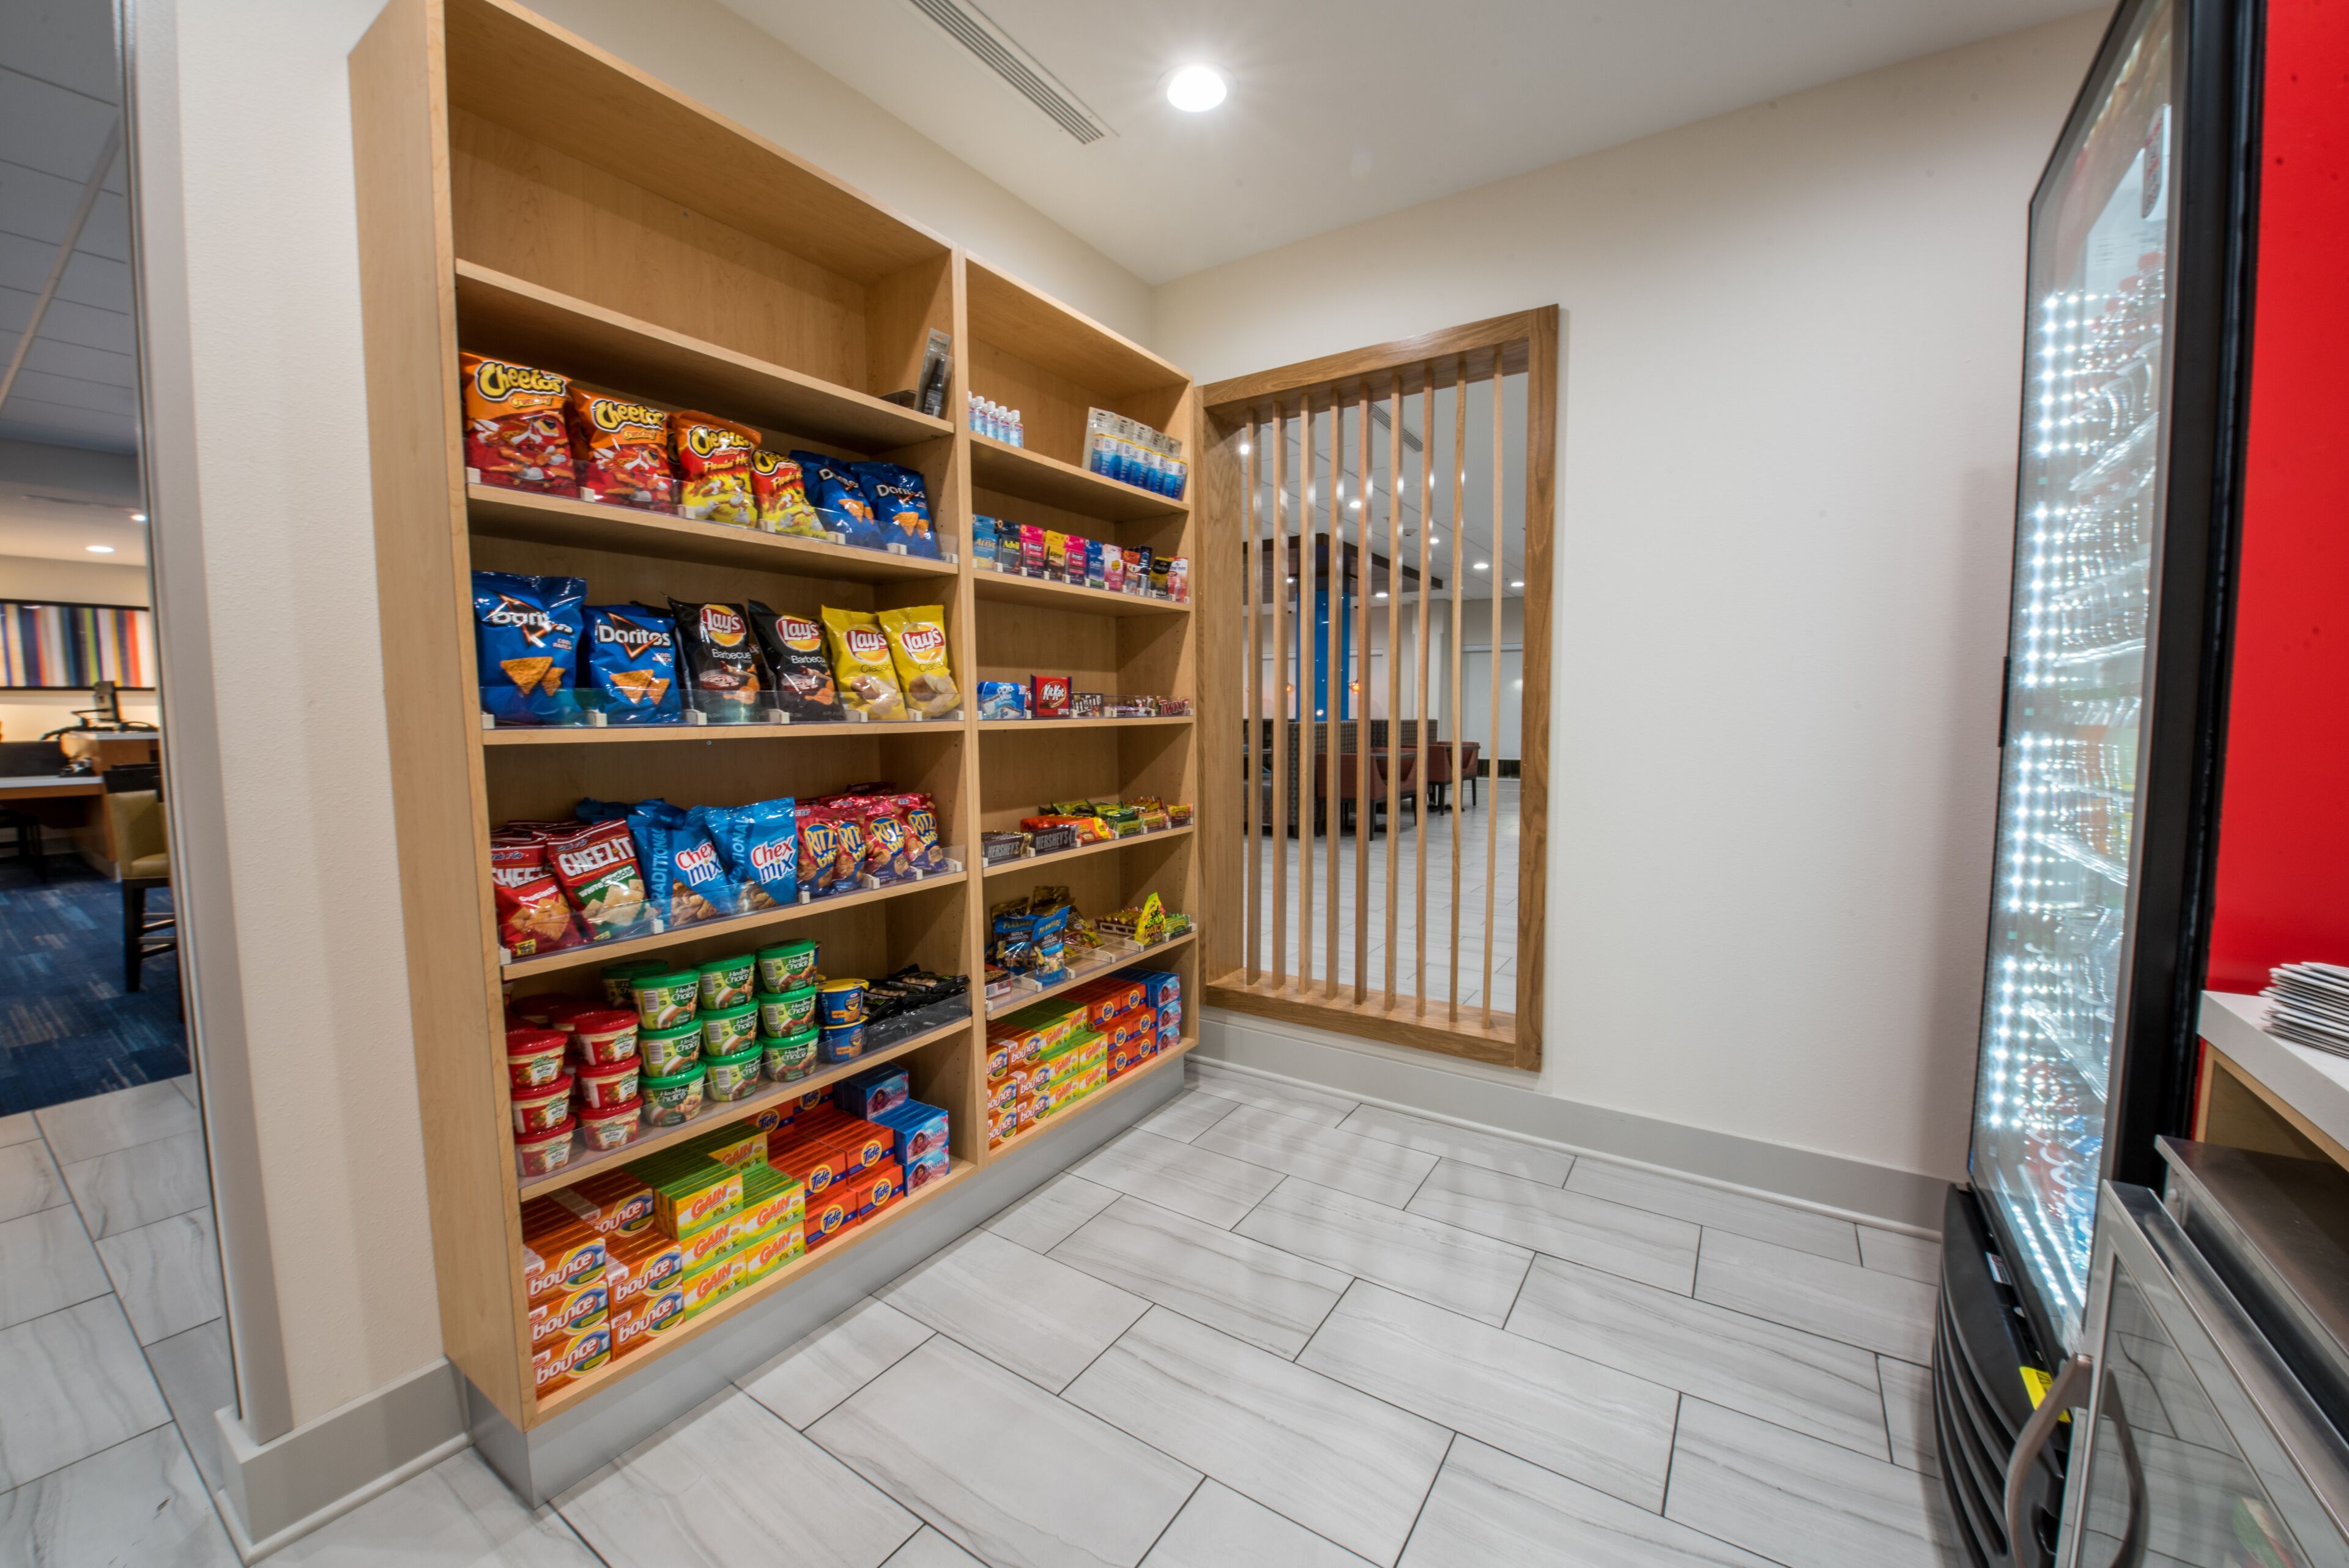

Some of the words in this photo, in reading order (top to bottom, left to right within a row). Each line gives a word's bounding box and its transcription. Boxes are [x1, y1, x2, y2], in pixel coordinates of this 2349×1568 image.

[477, 361, 565, 400] Cheetos
[592, 399, 666, 432] Cheetos
[707, 609, 741, 634] Lay's
[782, 620, 820, 641] Lay's
[598, 625, 671, 646] Doritos
[851, 630, 887, 652] Lay's
[905, 628, 943, 652] Lay's
[711, 648, 752, 660] Barbecue
[861, 664, 892, 673] Classic
[870, 819, 903, 844] RITZ
[908, 813, 936, 836] RITZ
[804, 829, 837, 857] RITZ
[987, 841, 1020, 858] HERSHEY'S
[1036, 831, 1069, 850] HERSHEY'S
[677, 842, 716, 869] Chex
[752, 838, 794, 867] Chex
[1046, 1025, 1063, 1046] GAIN
[1012, 1041, 1036, 1063] bounce
[1086, 1041, 1101, 1059] GAIN
[1055, 1055, 1071, 1075] GAIN
[1020, 1072, 1045, 1094] bounce
[1086, 1066, 1100, 1087] GAIN
[801, 1090, 819, 1107] Tide
[1056, 1081, 1072, 1102] GAIN
[759, 1112, 778, 1131] Tide
[1020, 1101, 1045, 1123] bounce
[721, 1140, 754, 1165] GAIN
[863, 1145, 881, 1162] Tide
[811, 1169, 831, 1187] Tide
[691, 1184, 728, 1219] GAIN
[874, 1183, 891, 1201] Tide
[595, 1202, 642, 1233] ounce
[757, 1194, 790, 1227] GAIN
[823, 1209, 843, 1228] Tide
[694, 1223, 730, 1258] GAIN
[760, 1231, 792, 1265] GAIN
[530, 1252, 593, 1296] bounce
[616, 1259, 669, 1301] bounce
[697, 1262, 732, 1298] GAIN
[532, 1295, 594, 1340] bounce
[619, 1299, 672, 1342] bounce
[536, 1338, 597, 1384] bounce
